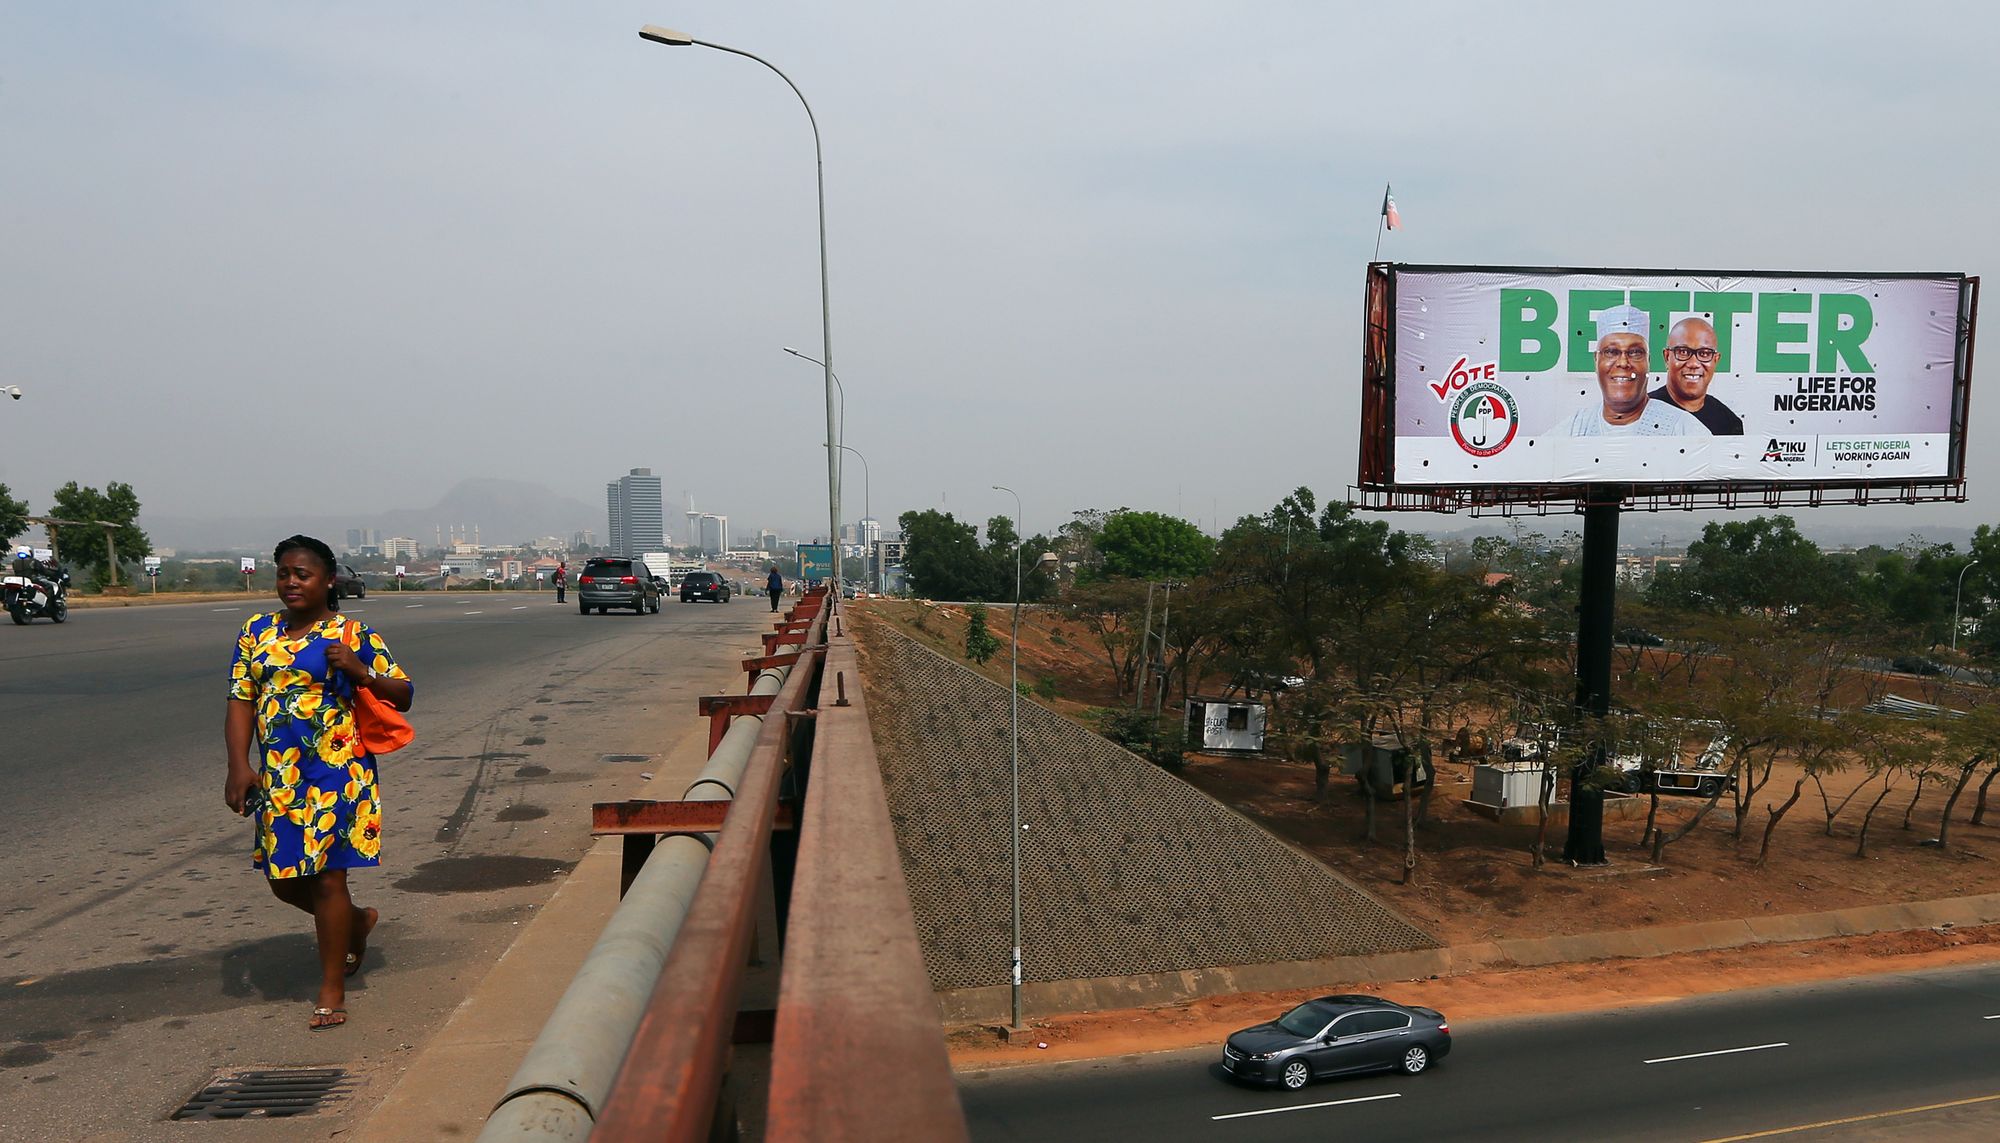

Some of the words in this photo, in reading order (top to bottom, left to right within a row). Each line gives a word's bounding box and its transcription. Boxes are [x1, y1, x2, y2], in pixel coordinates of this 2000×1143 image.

[1500, 289, 1875, 374] BETTER
[1430, 357, 1495, 400] VOTE
[1797, 377, 1836, 393] LIFE
[1839, 377, 1876, 393] FOR
[1451, 391, 1469, 418] PEOPLES
[1470, 383, 1508, 398] DEMOCRATIC
[1507, 397, 1518, 418] PARTY
[1774, 395, 1876, 411] NIGERIANS
[1760, 438, 1806, 462] ATIKU
[1826, 441, 1852, 451] LET'S
[1853, 441, 1873, 451] GET
[1873, 440, 1911, 450] NIGERIA
[1834, 452, 1879, 462] WORKING
[1880, 451, 1911, 461] AGAIN
